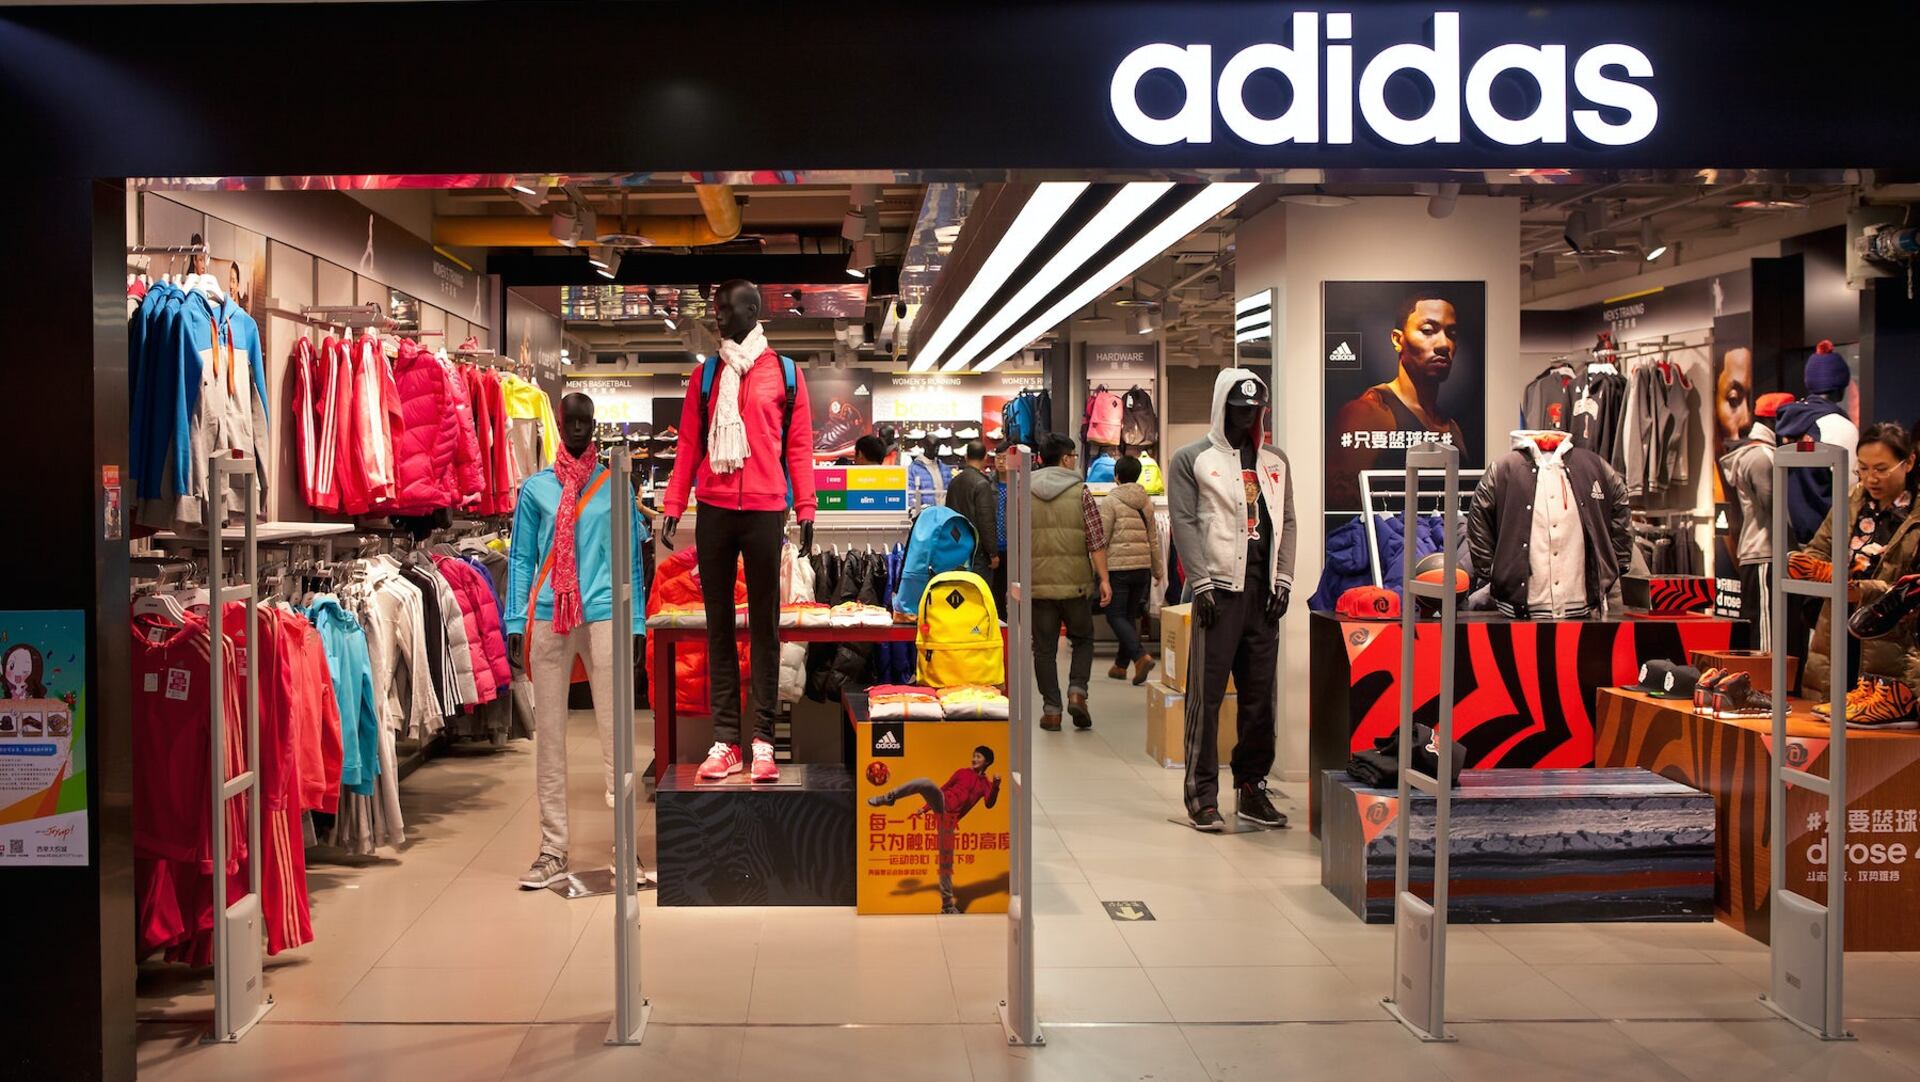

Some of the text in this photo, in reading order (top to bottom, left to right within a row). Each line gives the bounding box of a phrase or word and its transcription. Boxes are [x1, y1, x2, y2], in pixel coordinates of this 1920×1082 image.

[1110, 11, 1658, 145] adidas
[1096, 352, 1144, 361] HARDWARE
[1329, 353, 1356, 361] adidas
[566, 379, 632, 388] MEN'S BASKETBALL
[1002, 377, 1036, 385] WOMEN'S
[875, 741, 901, 750] adidas
[1806, 809, 1920, 833] #要篮球
[1806, 838, 1827, 865] d
